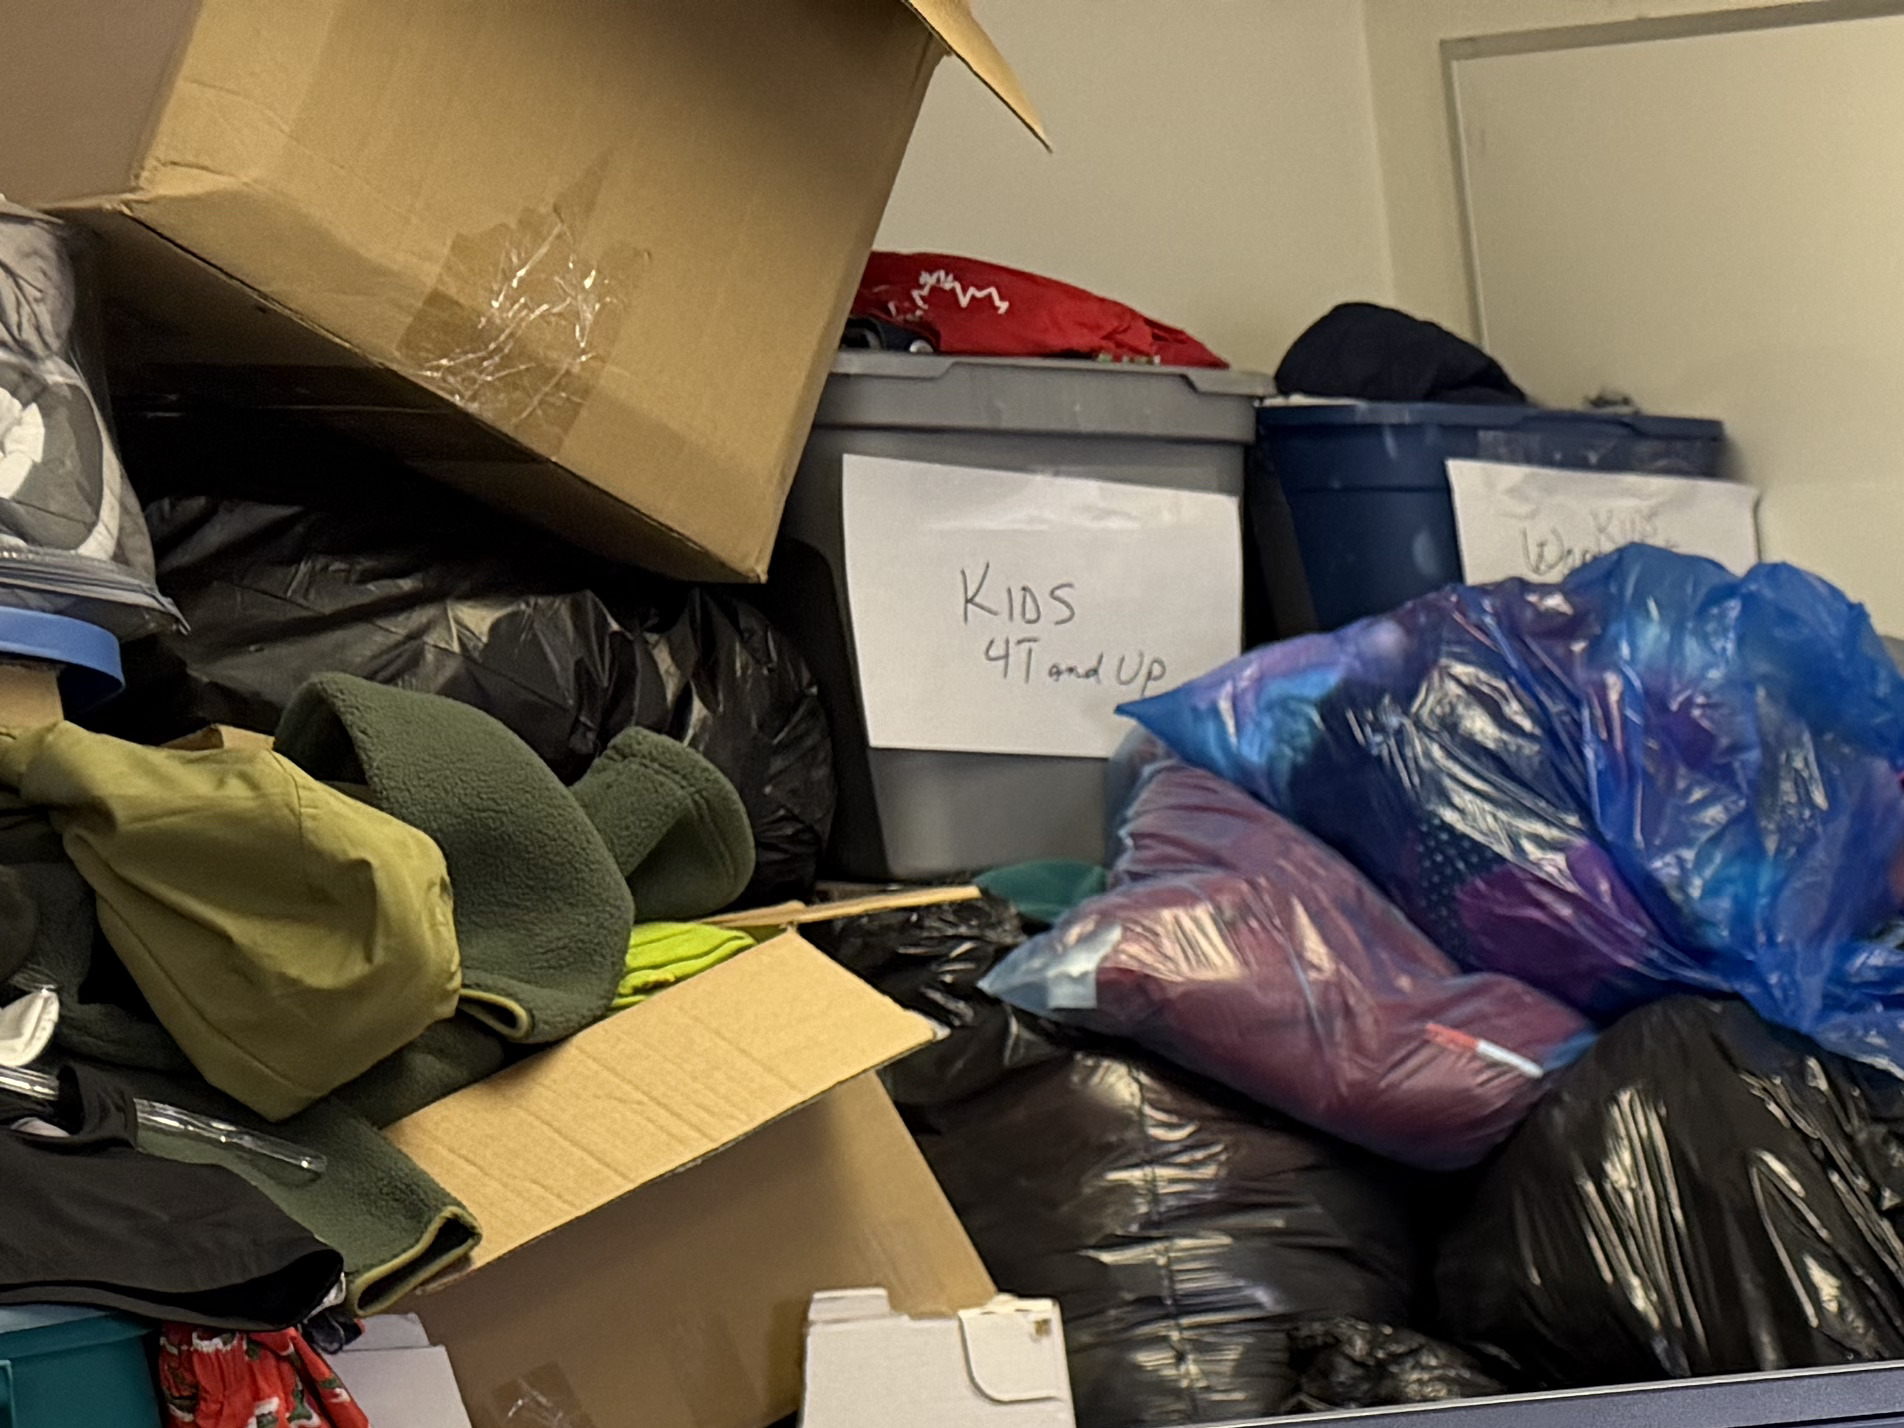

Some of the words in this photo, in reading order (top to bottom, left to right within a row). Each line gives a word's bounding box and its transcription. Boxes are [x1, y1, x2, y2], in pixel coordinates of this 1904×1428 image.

[961, 561, 1075, 625] KIDS
[984, 636, 1040, 684] 4T
[1048, 652, 1103, 683] and
